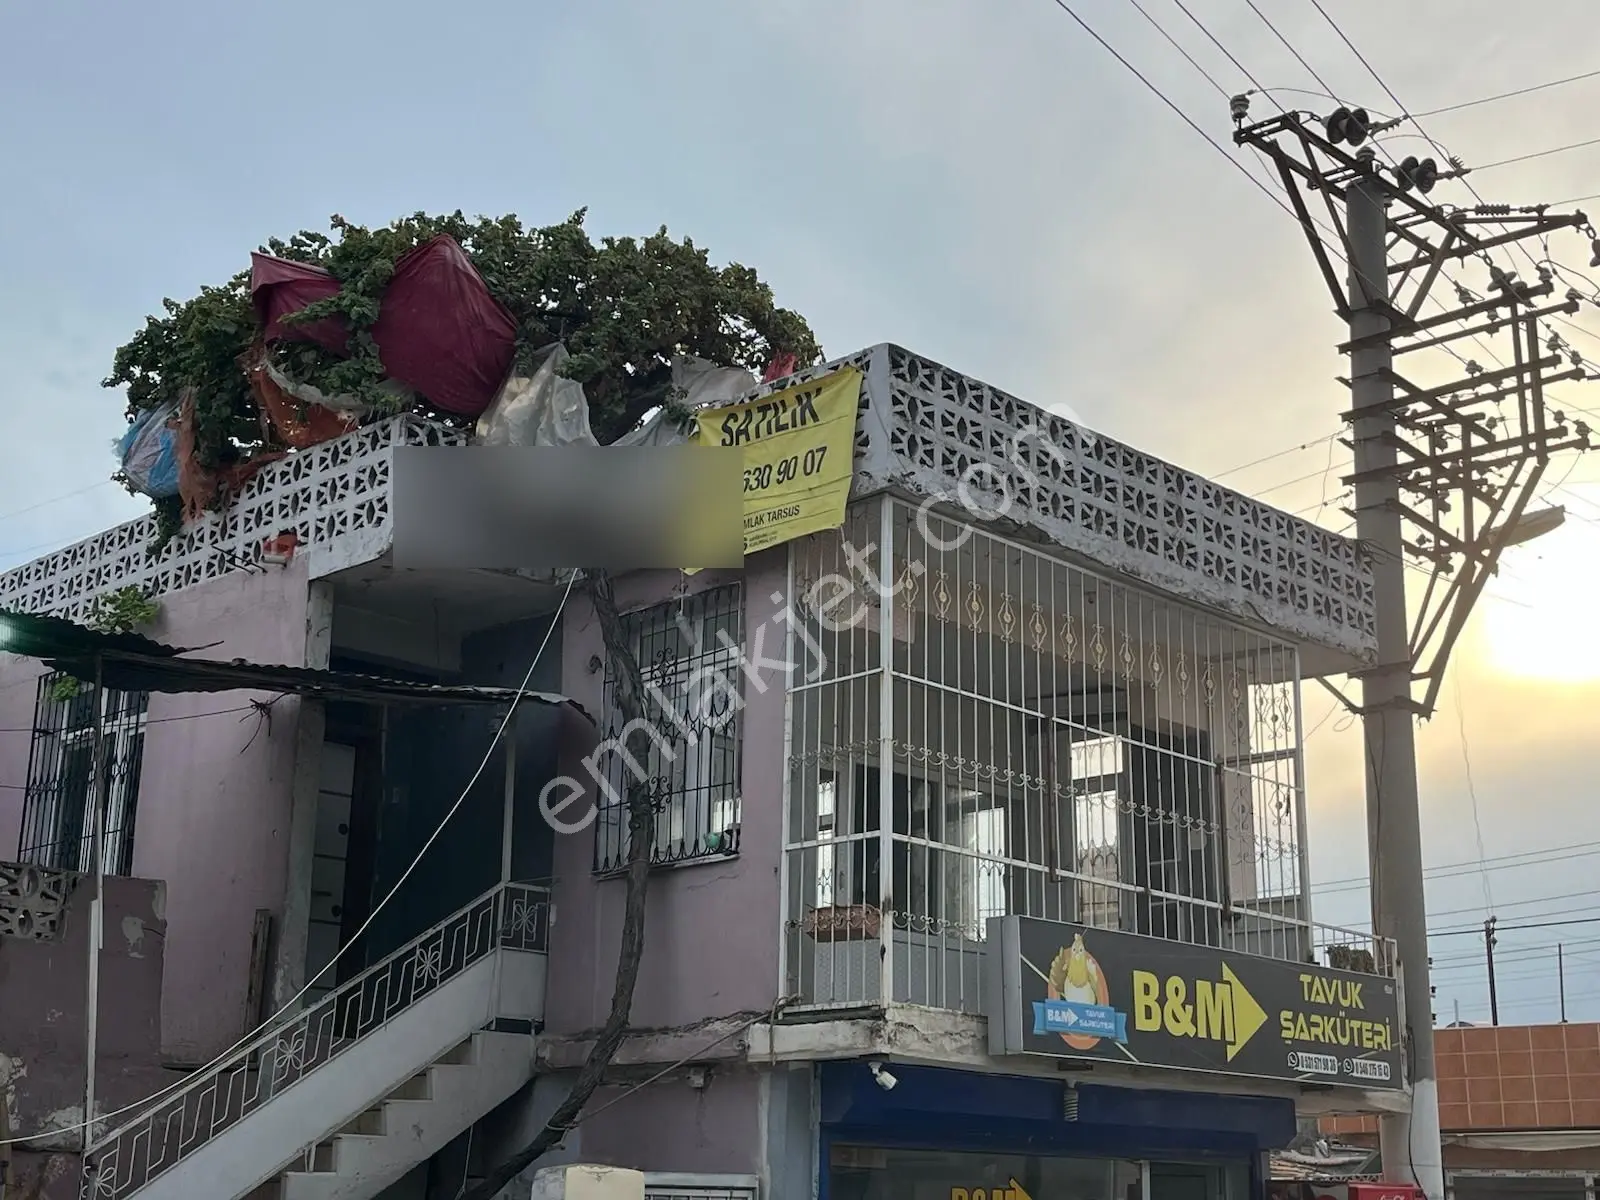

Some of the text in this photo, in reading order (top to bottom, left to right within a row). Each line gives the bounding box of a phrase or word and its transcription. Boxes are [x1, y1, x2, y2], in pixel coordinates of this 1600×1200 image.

[721, 387, 822, 446] SATILIK
[776, 456, 799, 485] 90
[803, 446, 827, 476] 07
[767, 505, 800, 522] TARSUS
[1132, 969, 1235, 1042] B&M
[1300, 974, 1364, 1009] TAVUK
[1280, 1010, 1391, 1051] ŞARKÜTERİ
